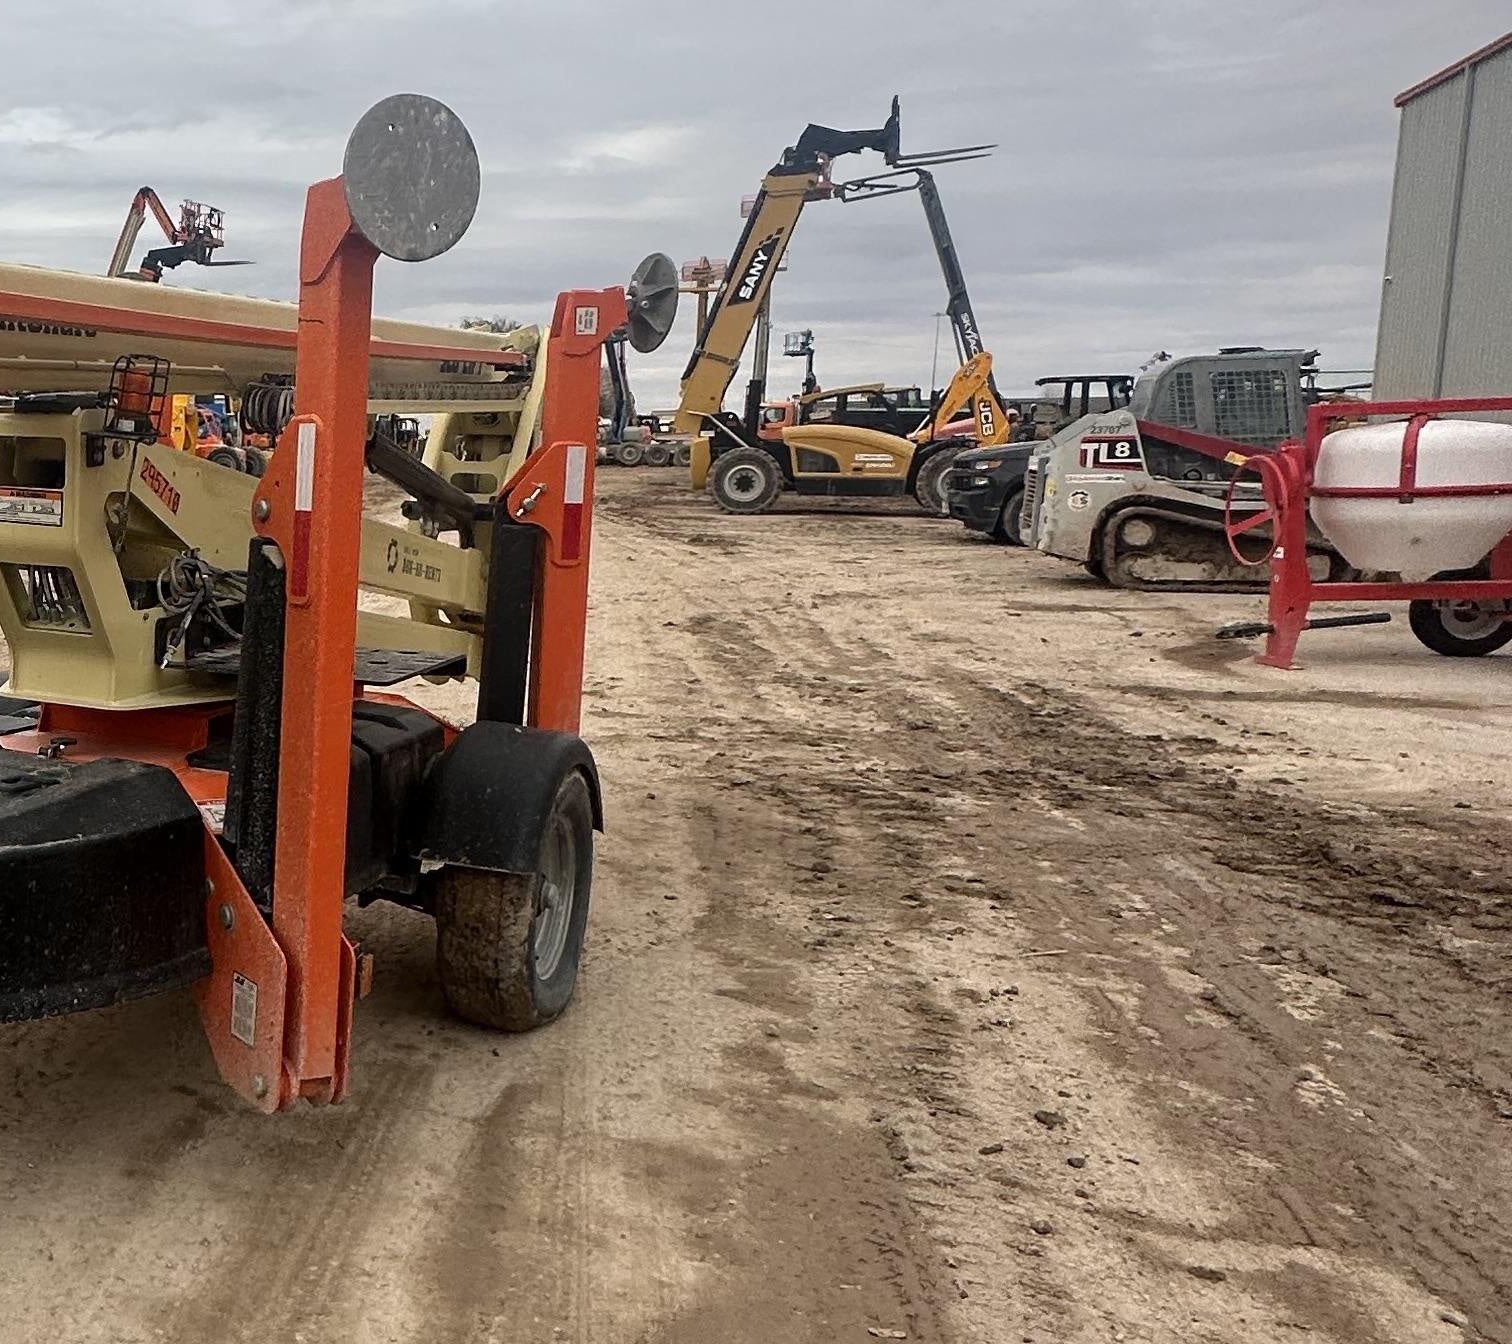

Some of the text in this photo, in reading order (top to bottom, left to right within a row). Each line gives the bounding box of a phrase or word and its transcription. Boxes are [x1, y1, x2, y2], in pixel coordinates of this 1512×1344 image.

[739, 249, 768, 300] SANY
[960, 312, 980, 357] SKYJAC
[979, 401, 995, 436] JCB
[1081, 441, 1142, 468] TL8
